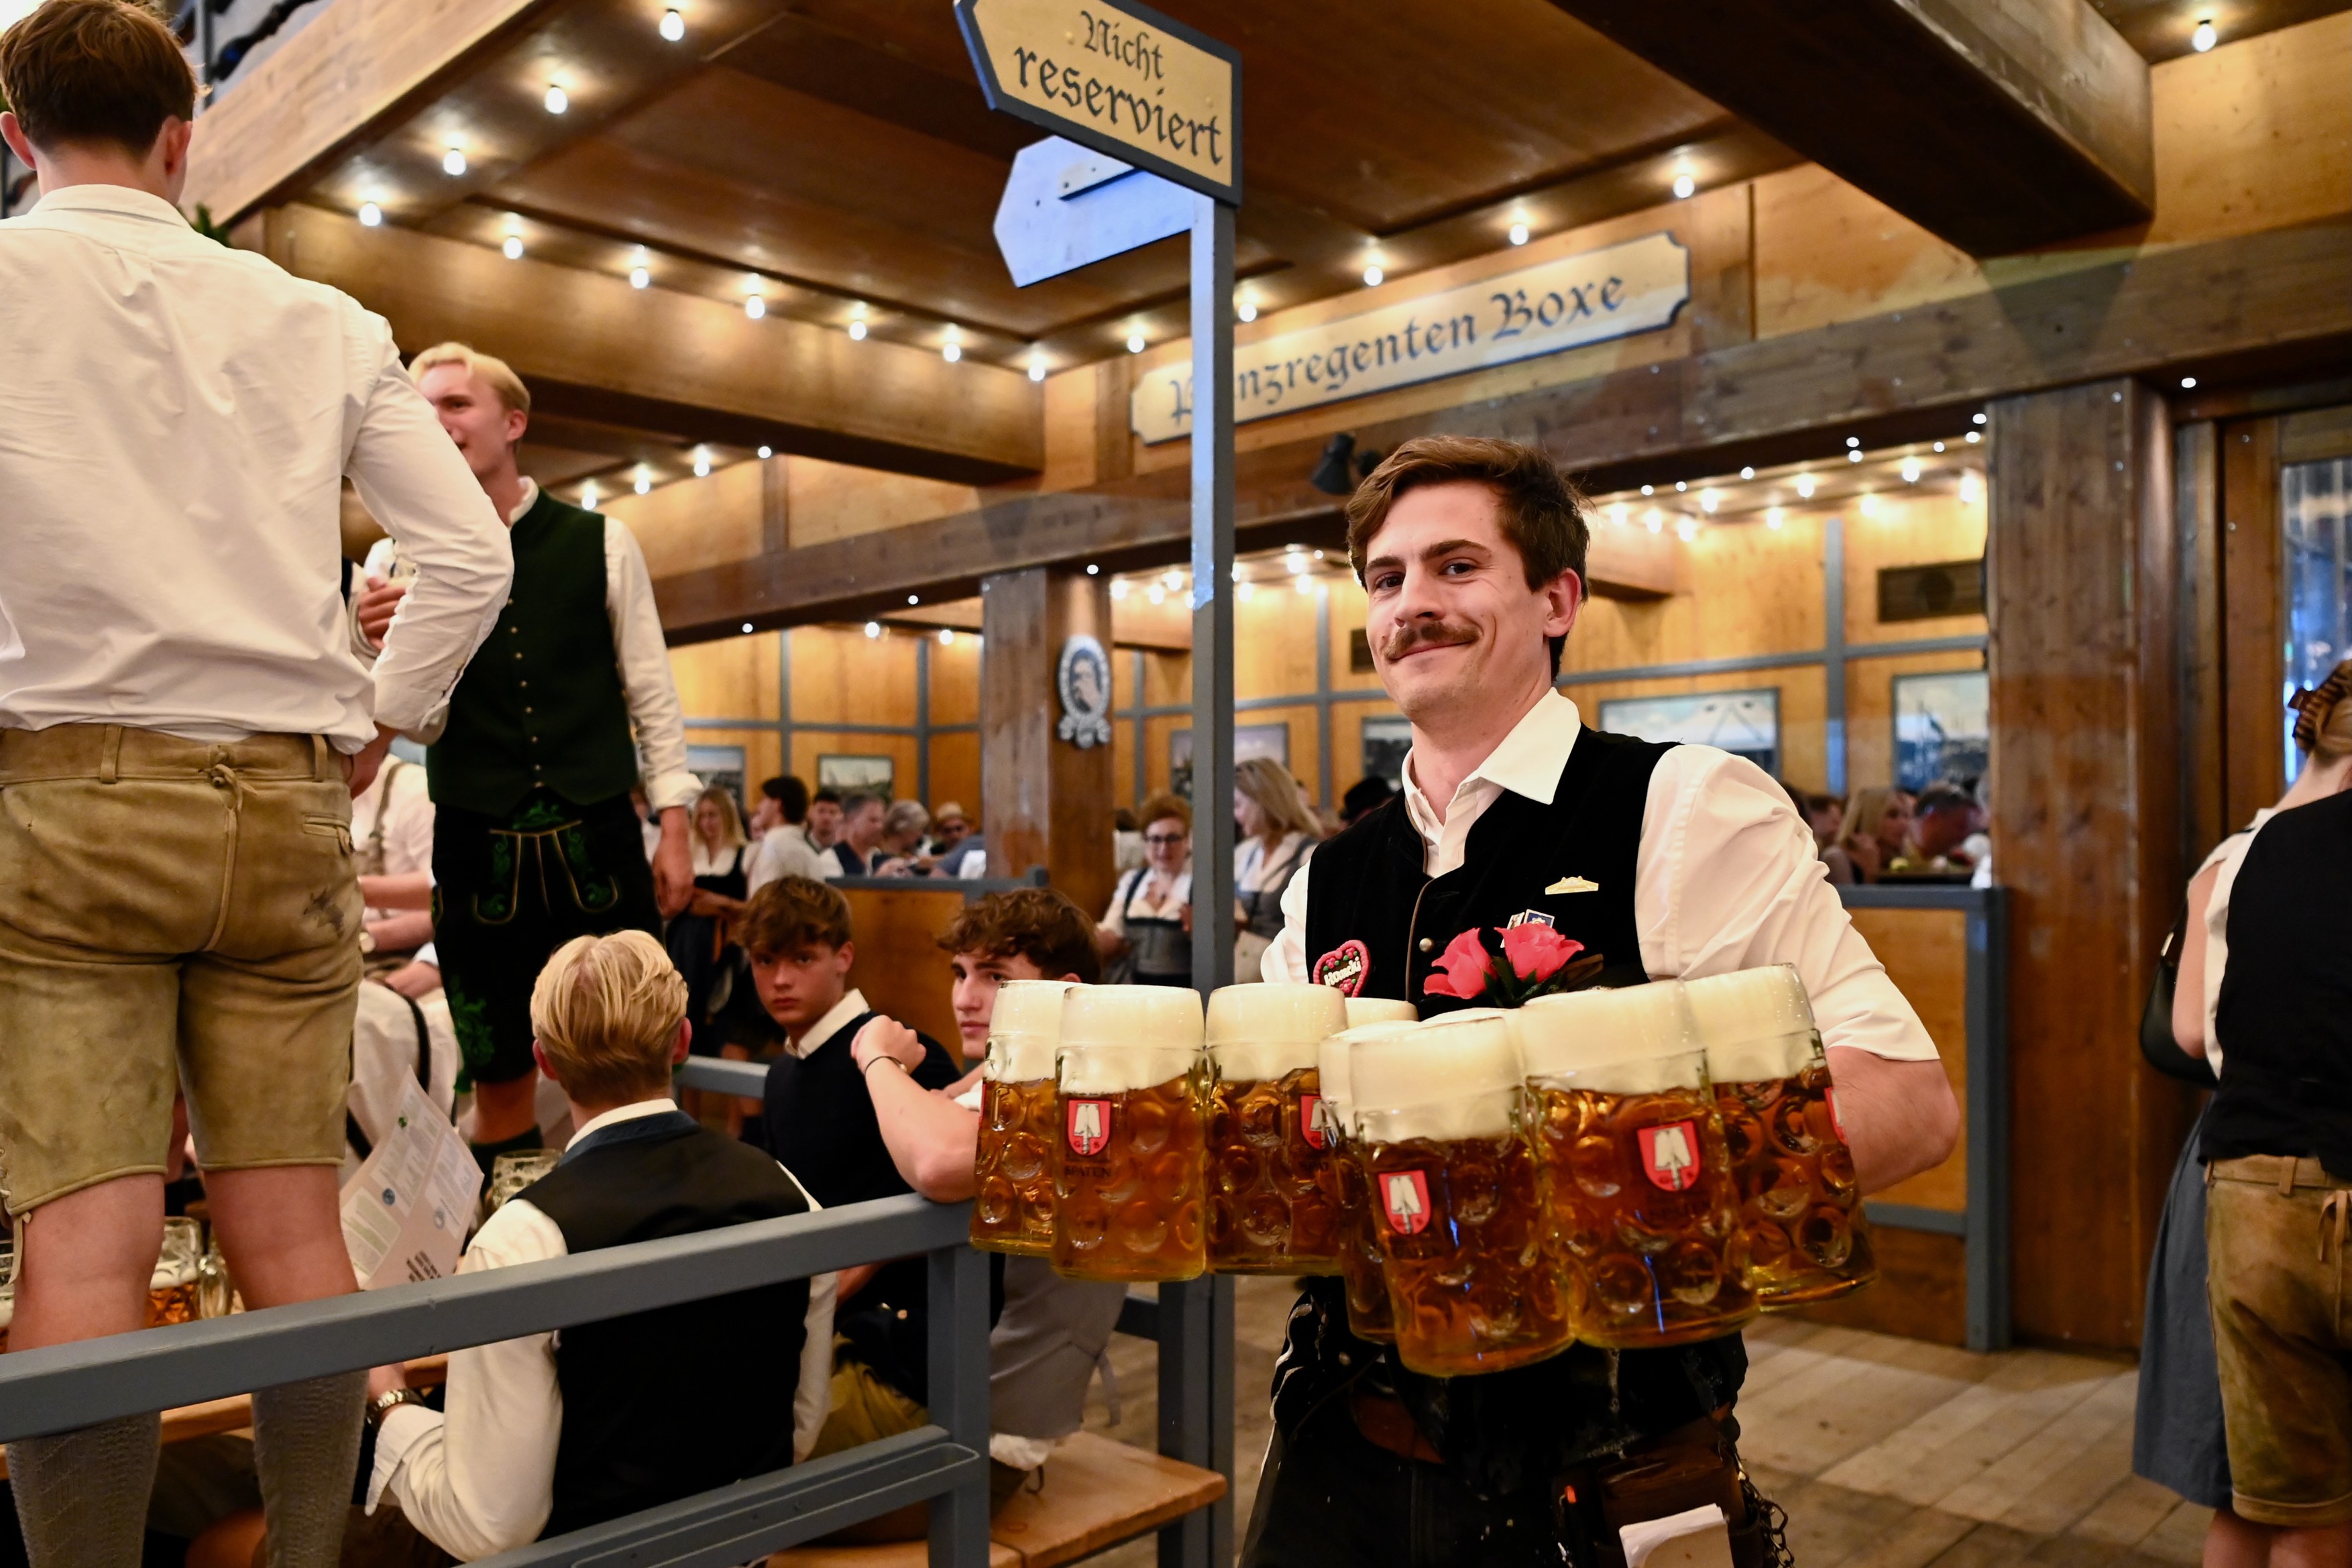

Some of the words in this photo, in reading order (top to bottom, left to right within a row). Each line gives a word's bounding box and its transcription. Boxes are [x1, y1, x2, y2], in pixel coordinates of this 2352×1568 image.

[1081, 10, 1164, 80] Nicht
[1014, 46, 1223, 165] reserviert
[1490, 277, 1626, 340] Boxe
